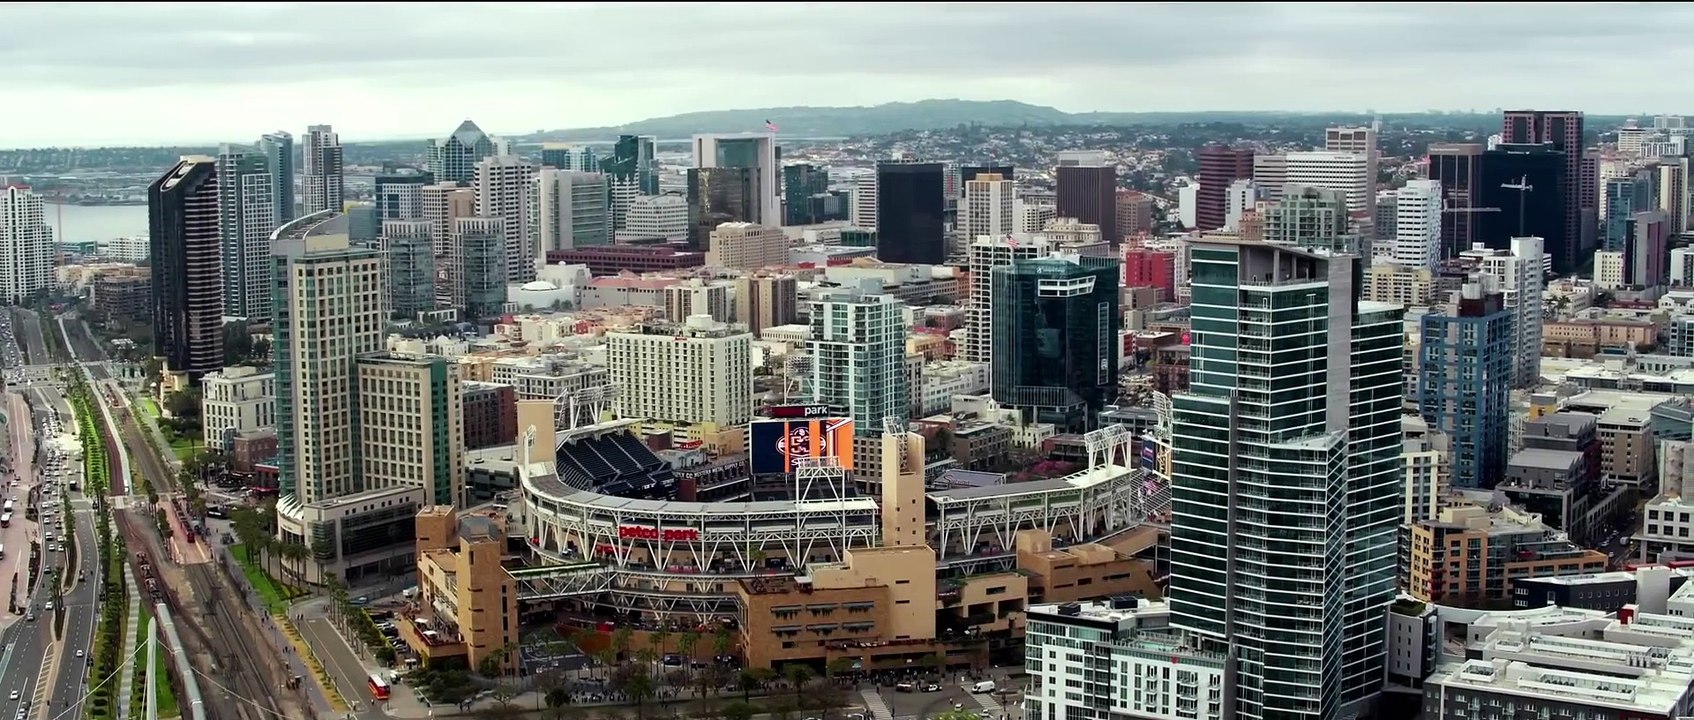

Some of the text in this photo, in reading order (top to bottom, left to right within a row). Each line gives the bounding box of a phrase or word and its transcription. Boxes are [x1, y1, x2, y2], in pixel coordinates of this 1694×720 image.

[804, 406, 828, 416] park
[619, 526, 698, 542] petco park
